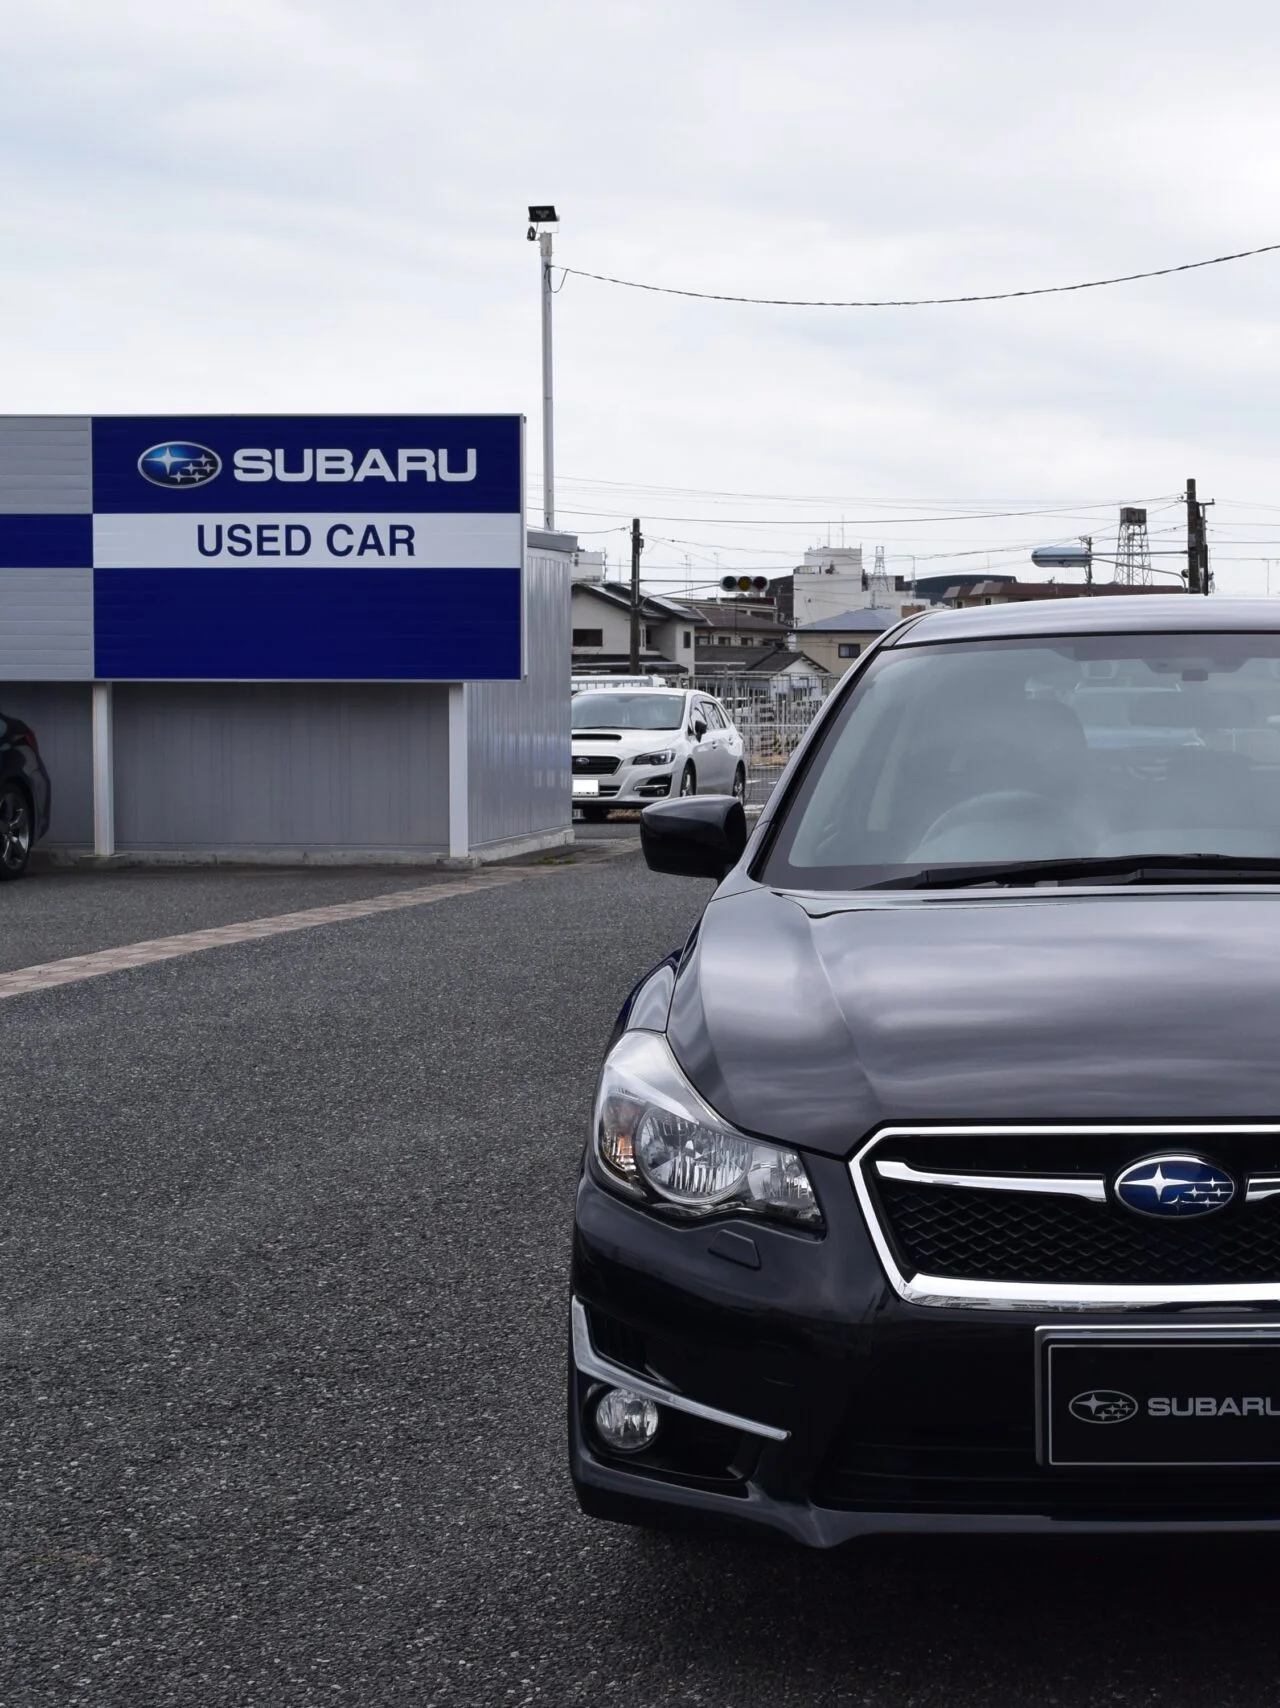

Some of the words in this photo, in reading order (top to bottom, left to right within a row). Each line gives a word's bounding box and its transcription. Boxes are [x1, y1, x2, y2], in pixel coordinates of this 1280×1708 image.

[233, 448, 477, 482] SUBARU
[197, 524, 312, 557] USED
[326, 524, 416, 557] CAR
